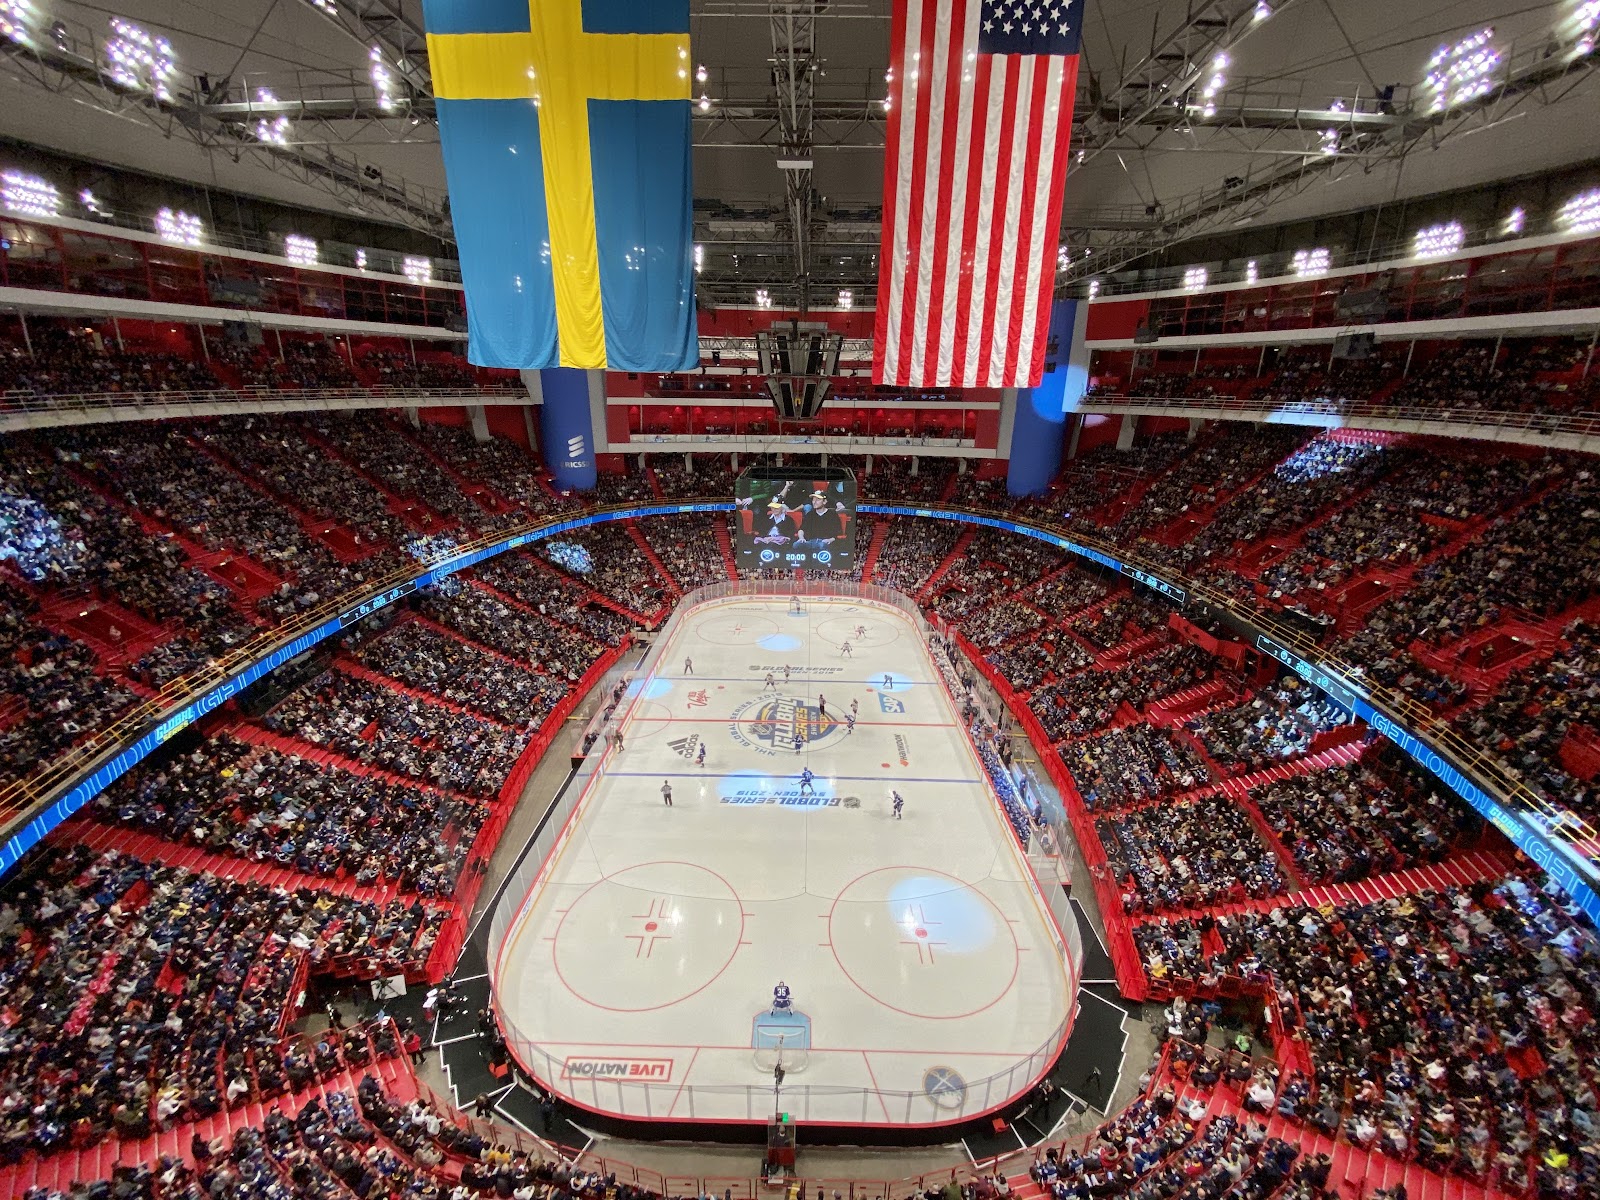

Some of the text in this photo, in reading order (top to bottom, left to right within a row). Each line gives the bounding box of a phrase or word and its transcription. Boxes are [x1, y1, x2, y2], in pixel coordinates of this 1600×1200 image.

[786, 553, 806, 561] 20:00
[882, 696, 901, 713] SAP
[155, 706, 195, 743] GLOBAL
[774, 698, 797, 749] GLOBAL
[684, 733, 699, 759] adidas
[754, 746, 776, 757] NHL
[1371, 711, 1486, 815] GET LOUD!
[1489, 804, 1524, 839] GLOBAL
[1525, 835, 1587, 896] GET
[777, 988, 786, 997] 35
[570, 1062, 666, 1076] LIVE NATION
